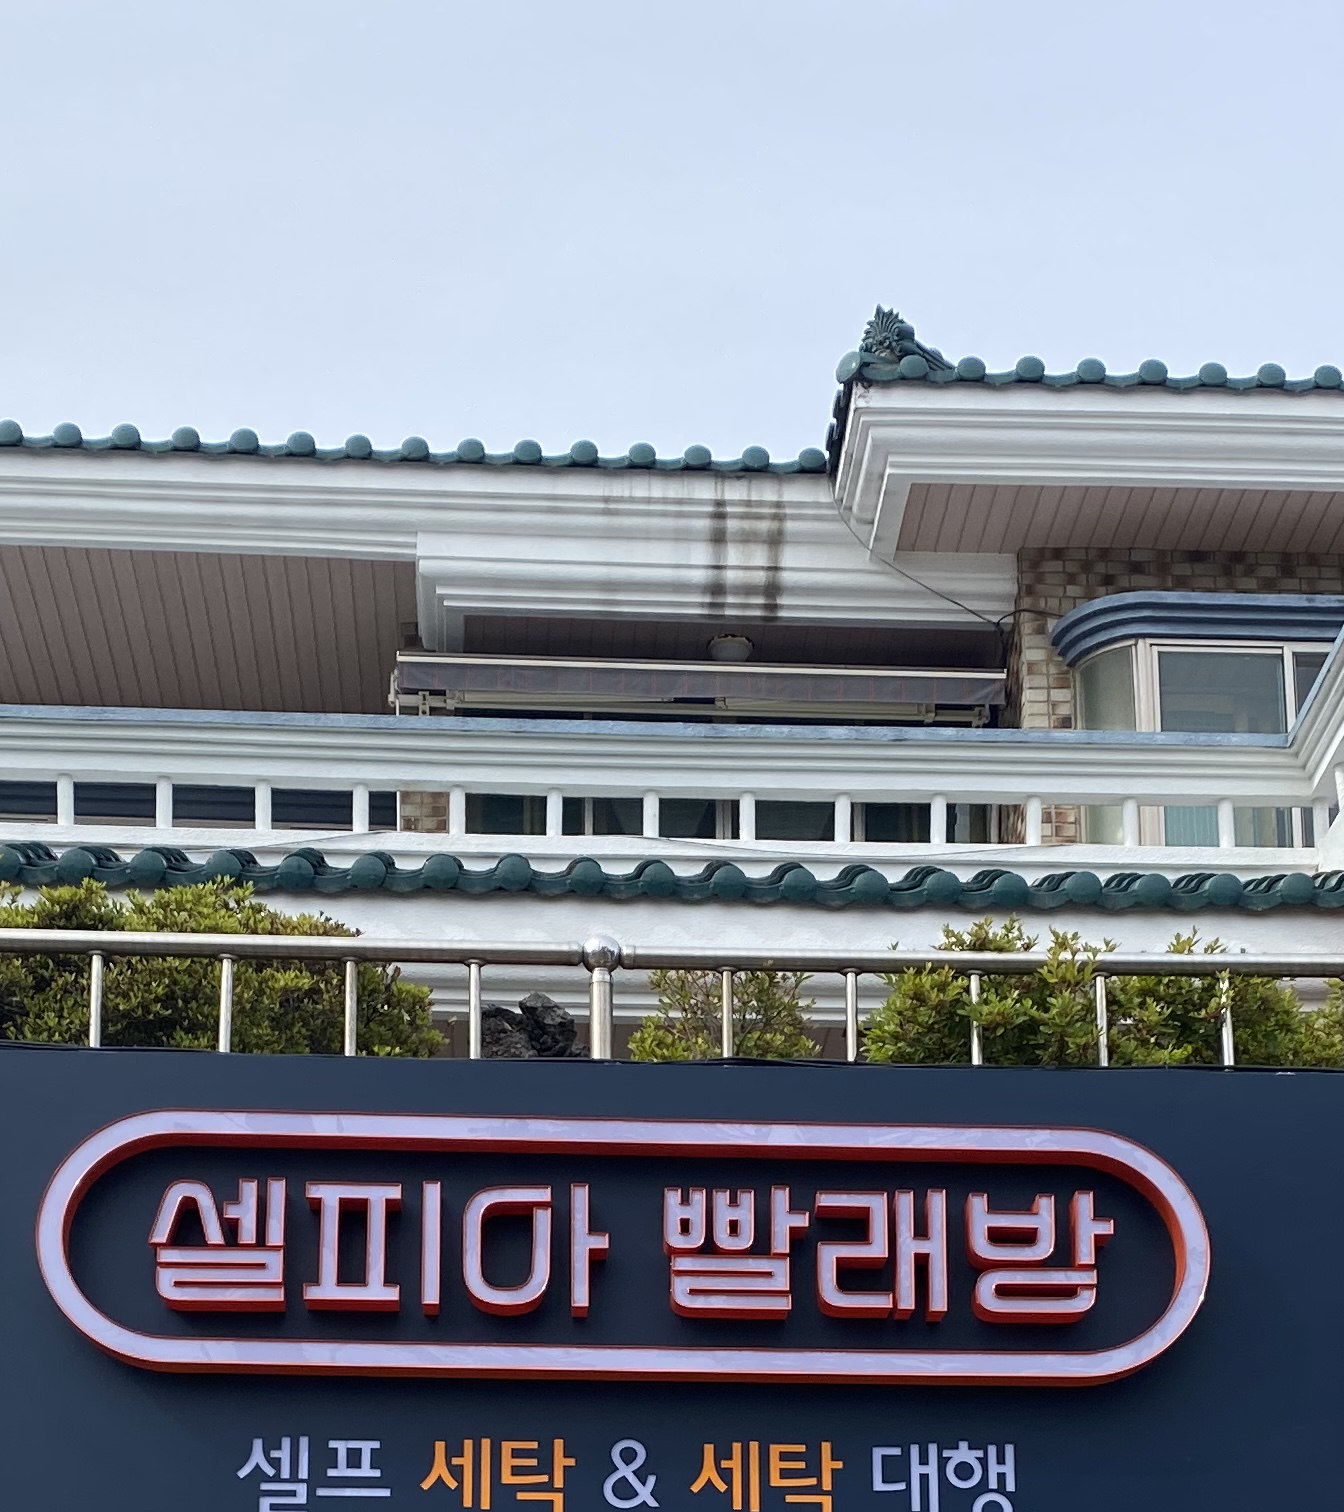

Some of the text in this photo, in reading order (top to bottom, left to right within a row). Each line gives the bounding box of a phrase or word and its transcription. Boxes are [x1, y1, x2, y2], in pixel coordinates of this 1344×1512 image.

[147, 1177, 1114, 1325] 셀피아 빨래방
[603, 1439, 660, 1509] &
